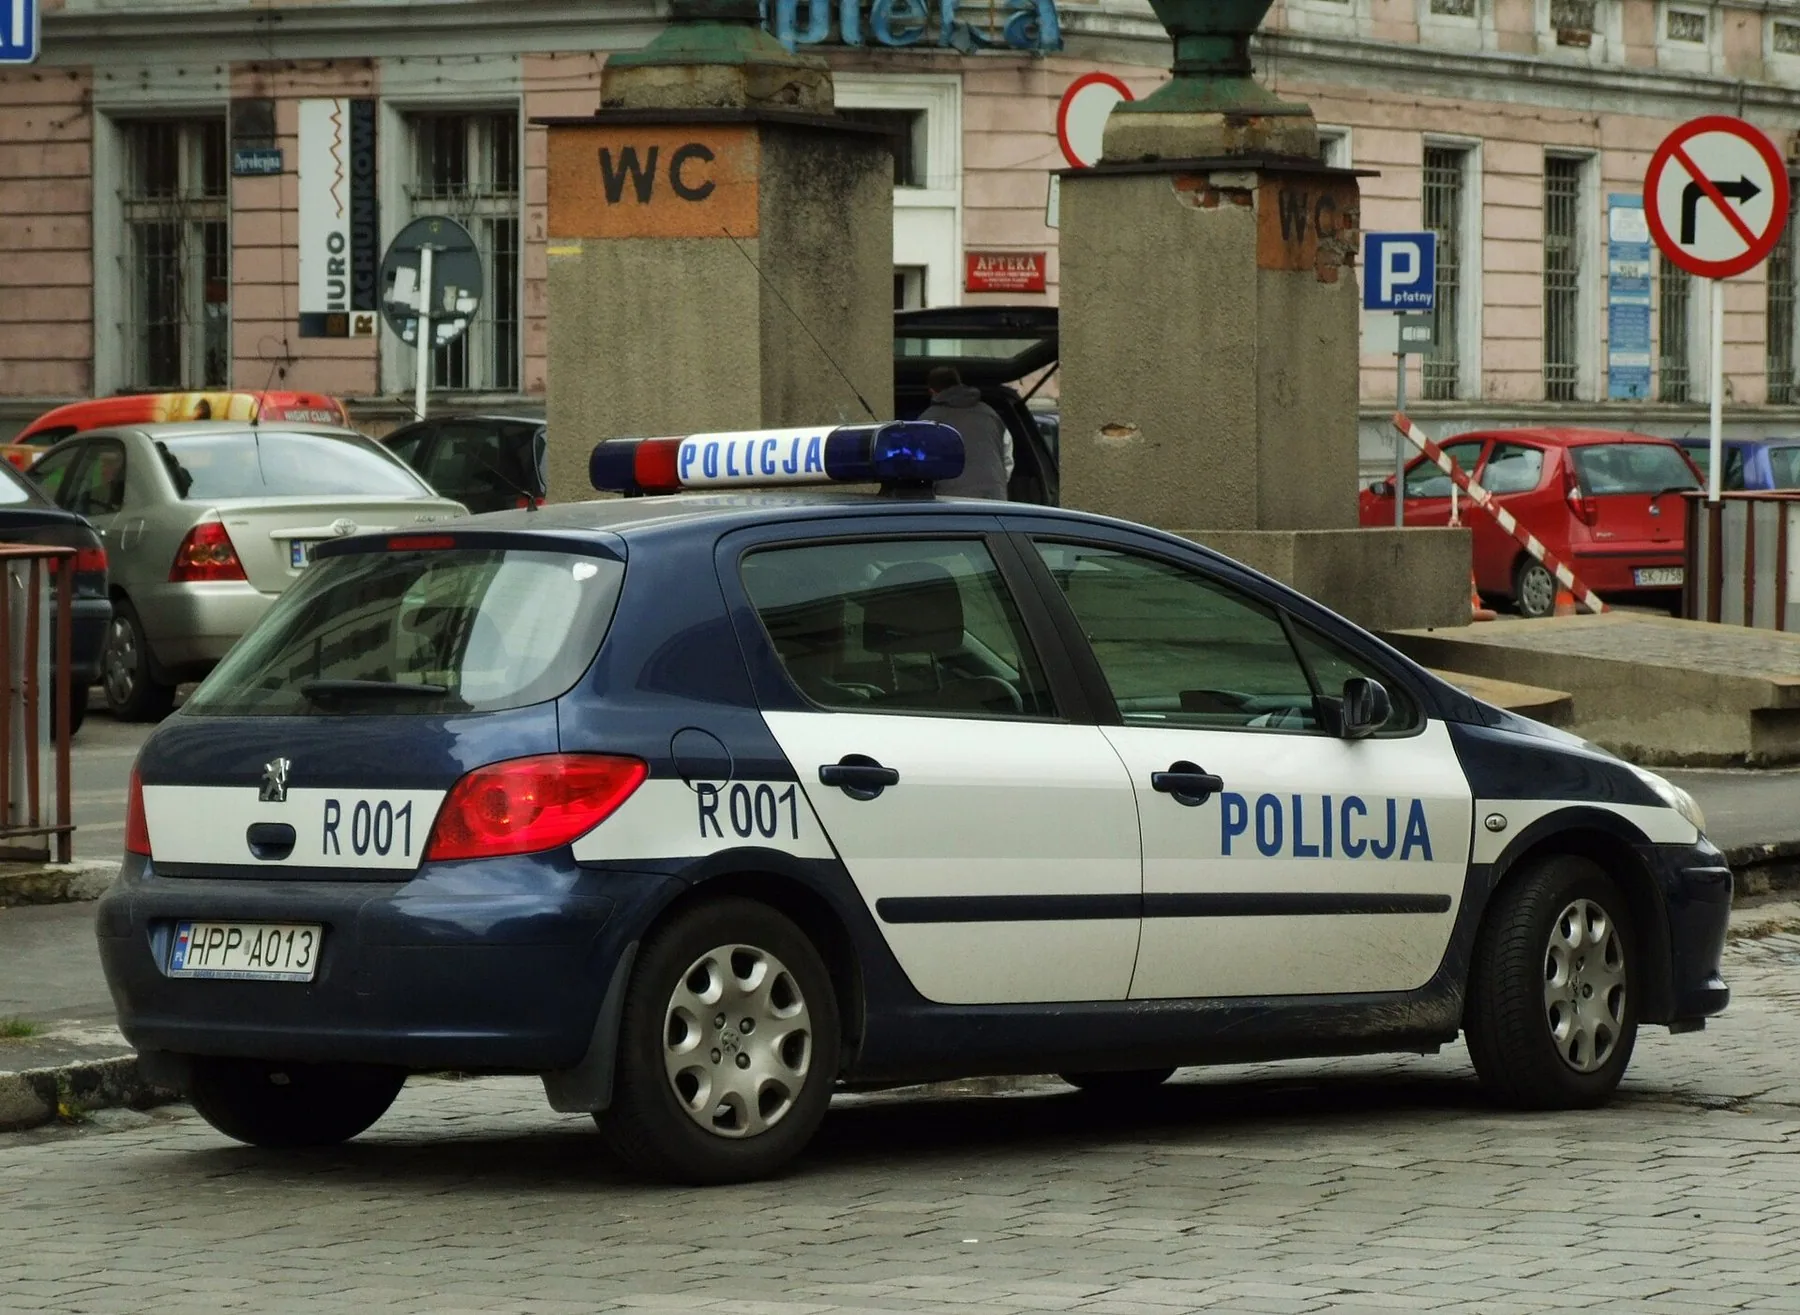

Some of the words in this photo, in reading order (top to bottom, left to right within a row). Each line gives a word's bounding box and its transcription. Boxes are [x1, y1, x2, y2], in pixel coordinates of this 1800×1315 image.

[598, 143, 716, 205] WC
[1278, 190, 1337, 244] WC
[977, 257, 1037, 270] APTEKA
[1381, 241, 1420, 302] P
[681, 436, 823, 479] POLICJA
[323, 799, 341, 855] R
[352, 800, 412, 856] 001
[697, 783, 724, 838] R
[729, 783, 798, 839] 001
[1221, 792, 1433, 861] POLICJA
[187, 927, 243, 966] HPP
[248, 928, 314, 968] A013
